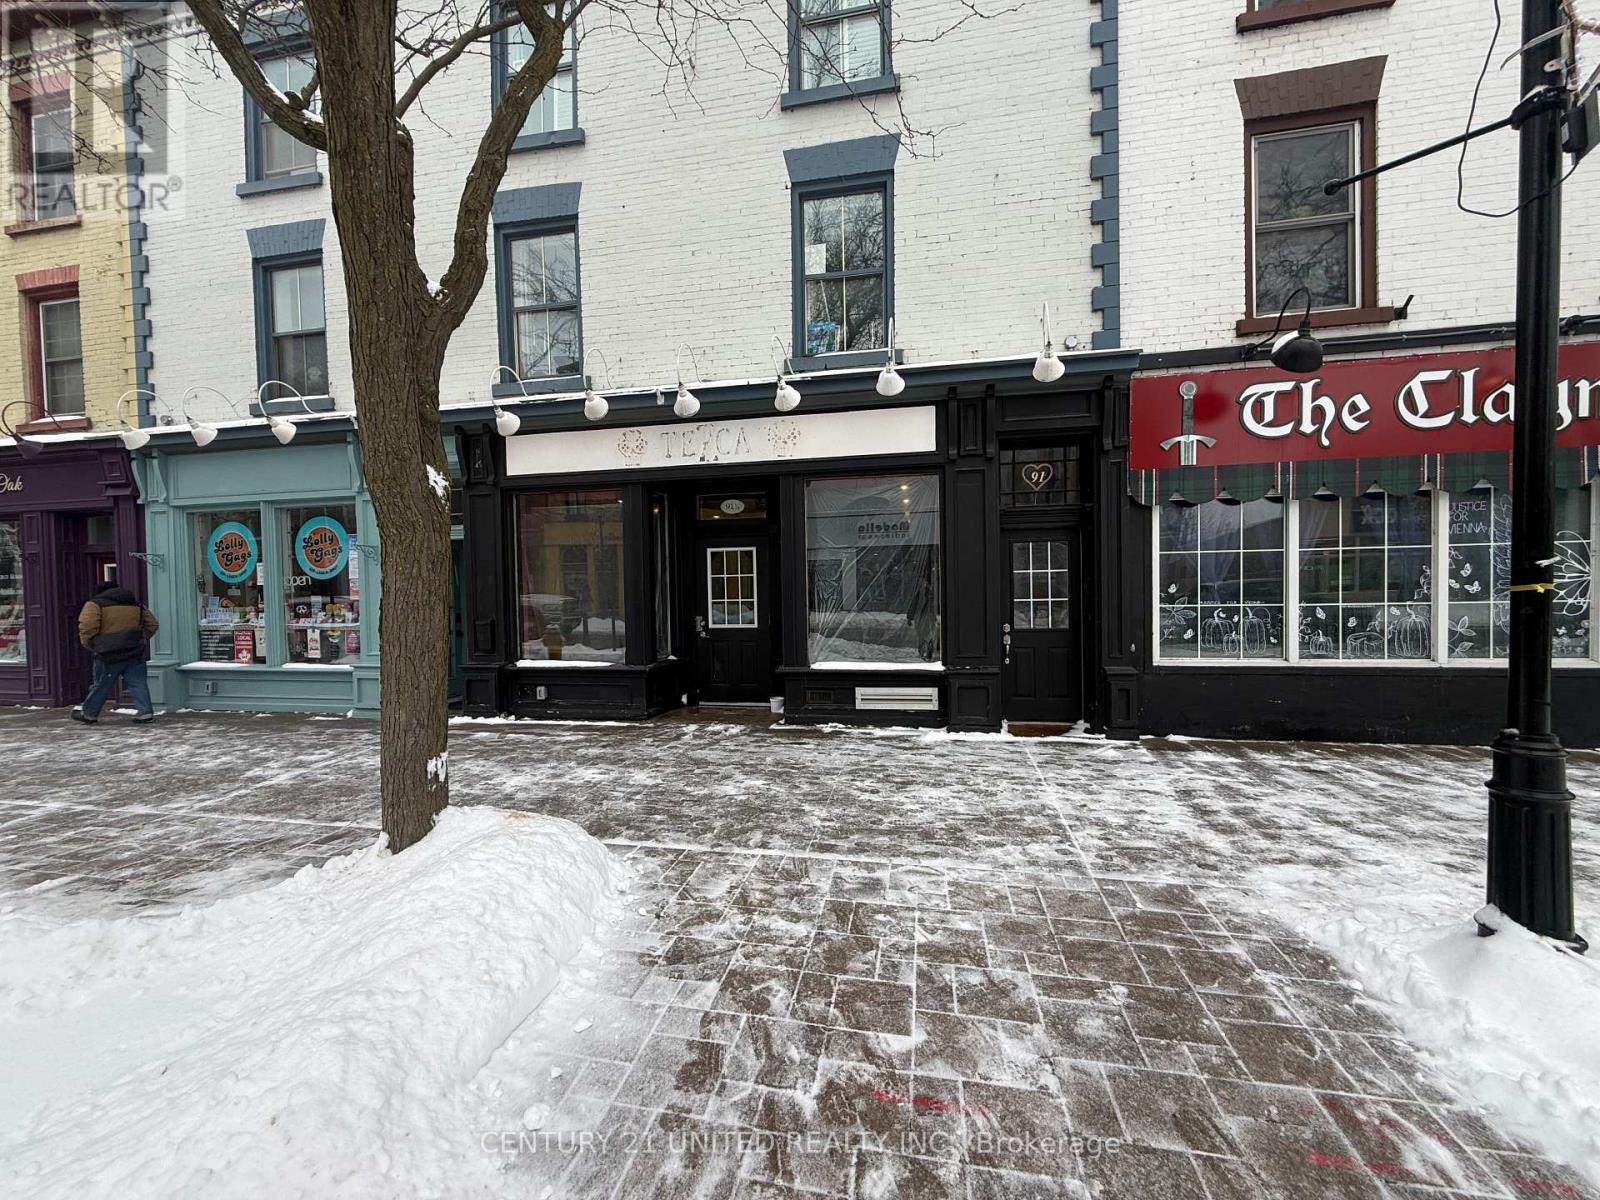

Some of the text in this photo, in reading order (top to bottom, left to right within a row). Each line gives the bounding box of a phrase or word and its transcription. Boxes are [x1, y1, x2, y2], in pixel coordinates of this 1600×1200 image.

[1238, 378, 1372, 447] The
[1031, 471, 1047, 483] 91
[214, 537, 244, 553] Lolly
[303, 532, 335, 549] Lolly
[222, 550, 252, 567] Gags
[310, 546, 343, 563] Gags
